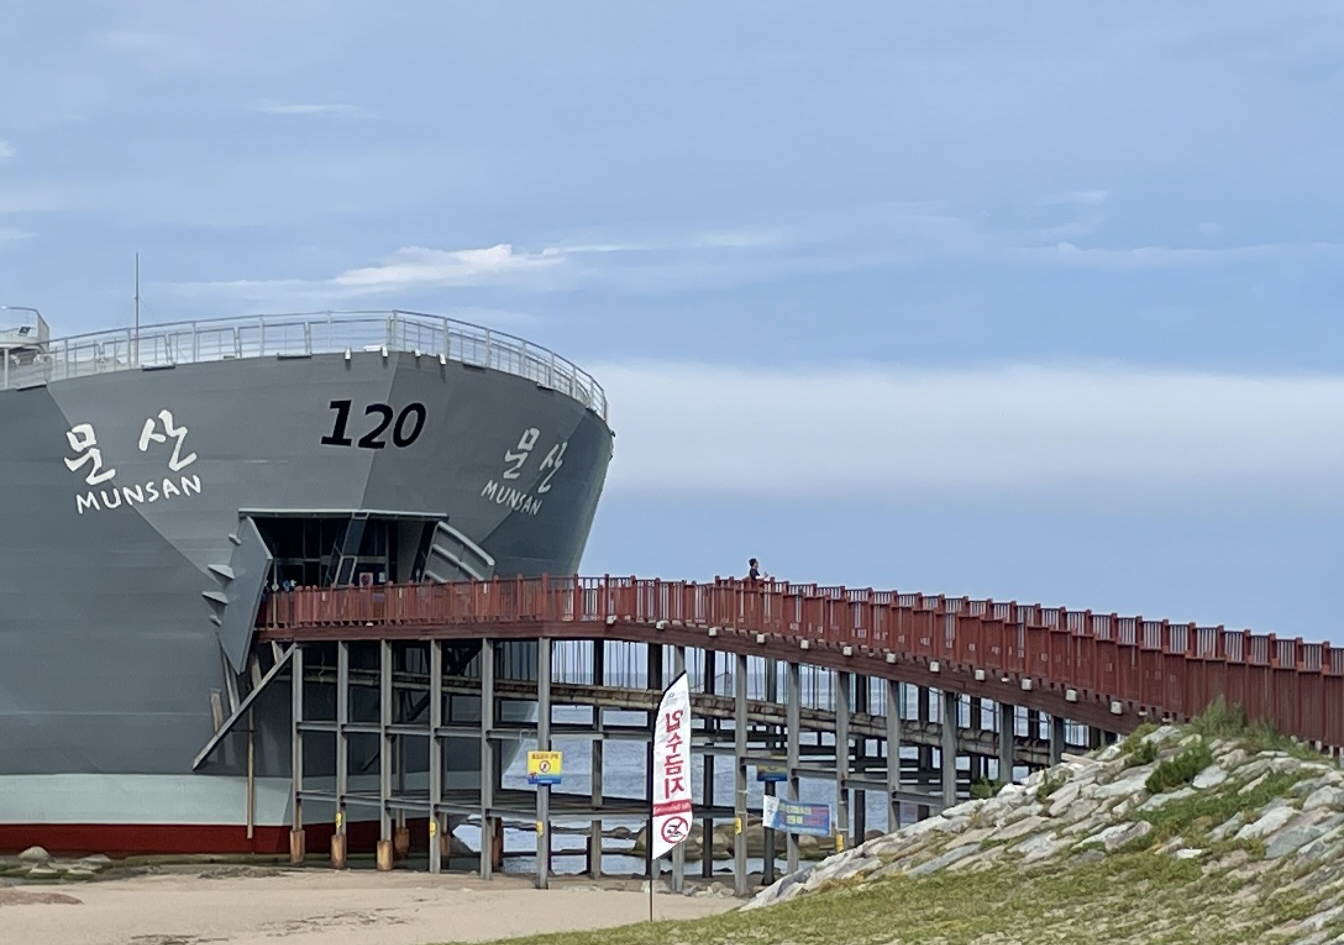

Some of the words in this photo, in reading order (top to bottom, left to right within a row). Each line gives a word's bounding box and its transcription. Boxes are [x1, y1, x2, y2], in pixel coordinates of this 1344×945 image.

[320, 399, 427, 449] 120
[76, 475, 201, 514] MUNSAN
[481, 480, 542, 515] MUNSAN
